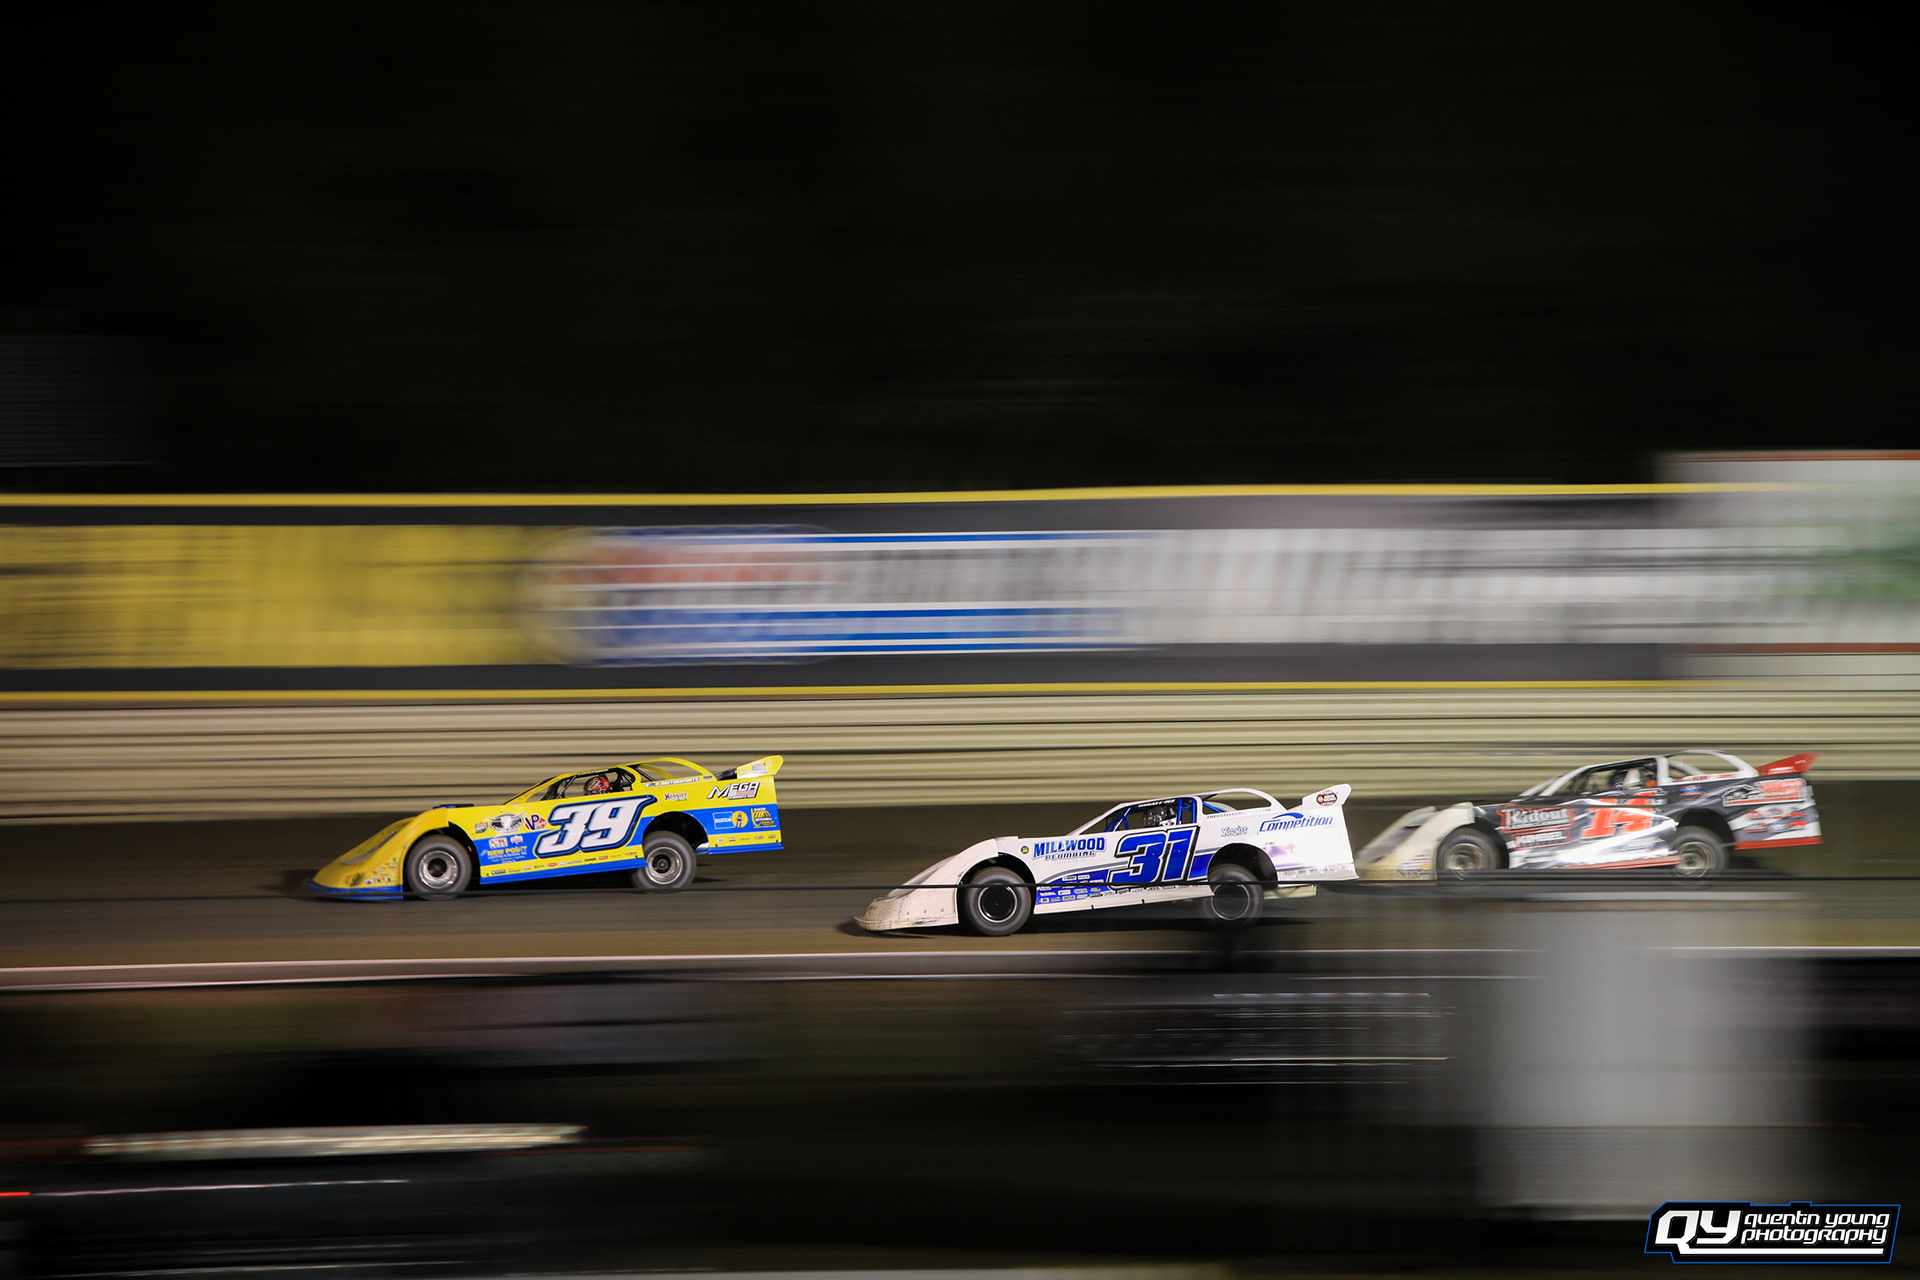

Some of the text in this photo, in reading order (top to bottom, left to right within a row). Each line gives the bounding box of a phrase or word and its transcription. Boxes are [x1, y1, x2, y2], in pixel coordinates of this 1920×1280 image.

[534, 795, 657, 858] 39
[1259, 815, 1333, 832] Competition
[1033, 836, 1105, 858] MILLWOOD
[1109, 827, 1199, 886] 31
